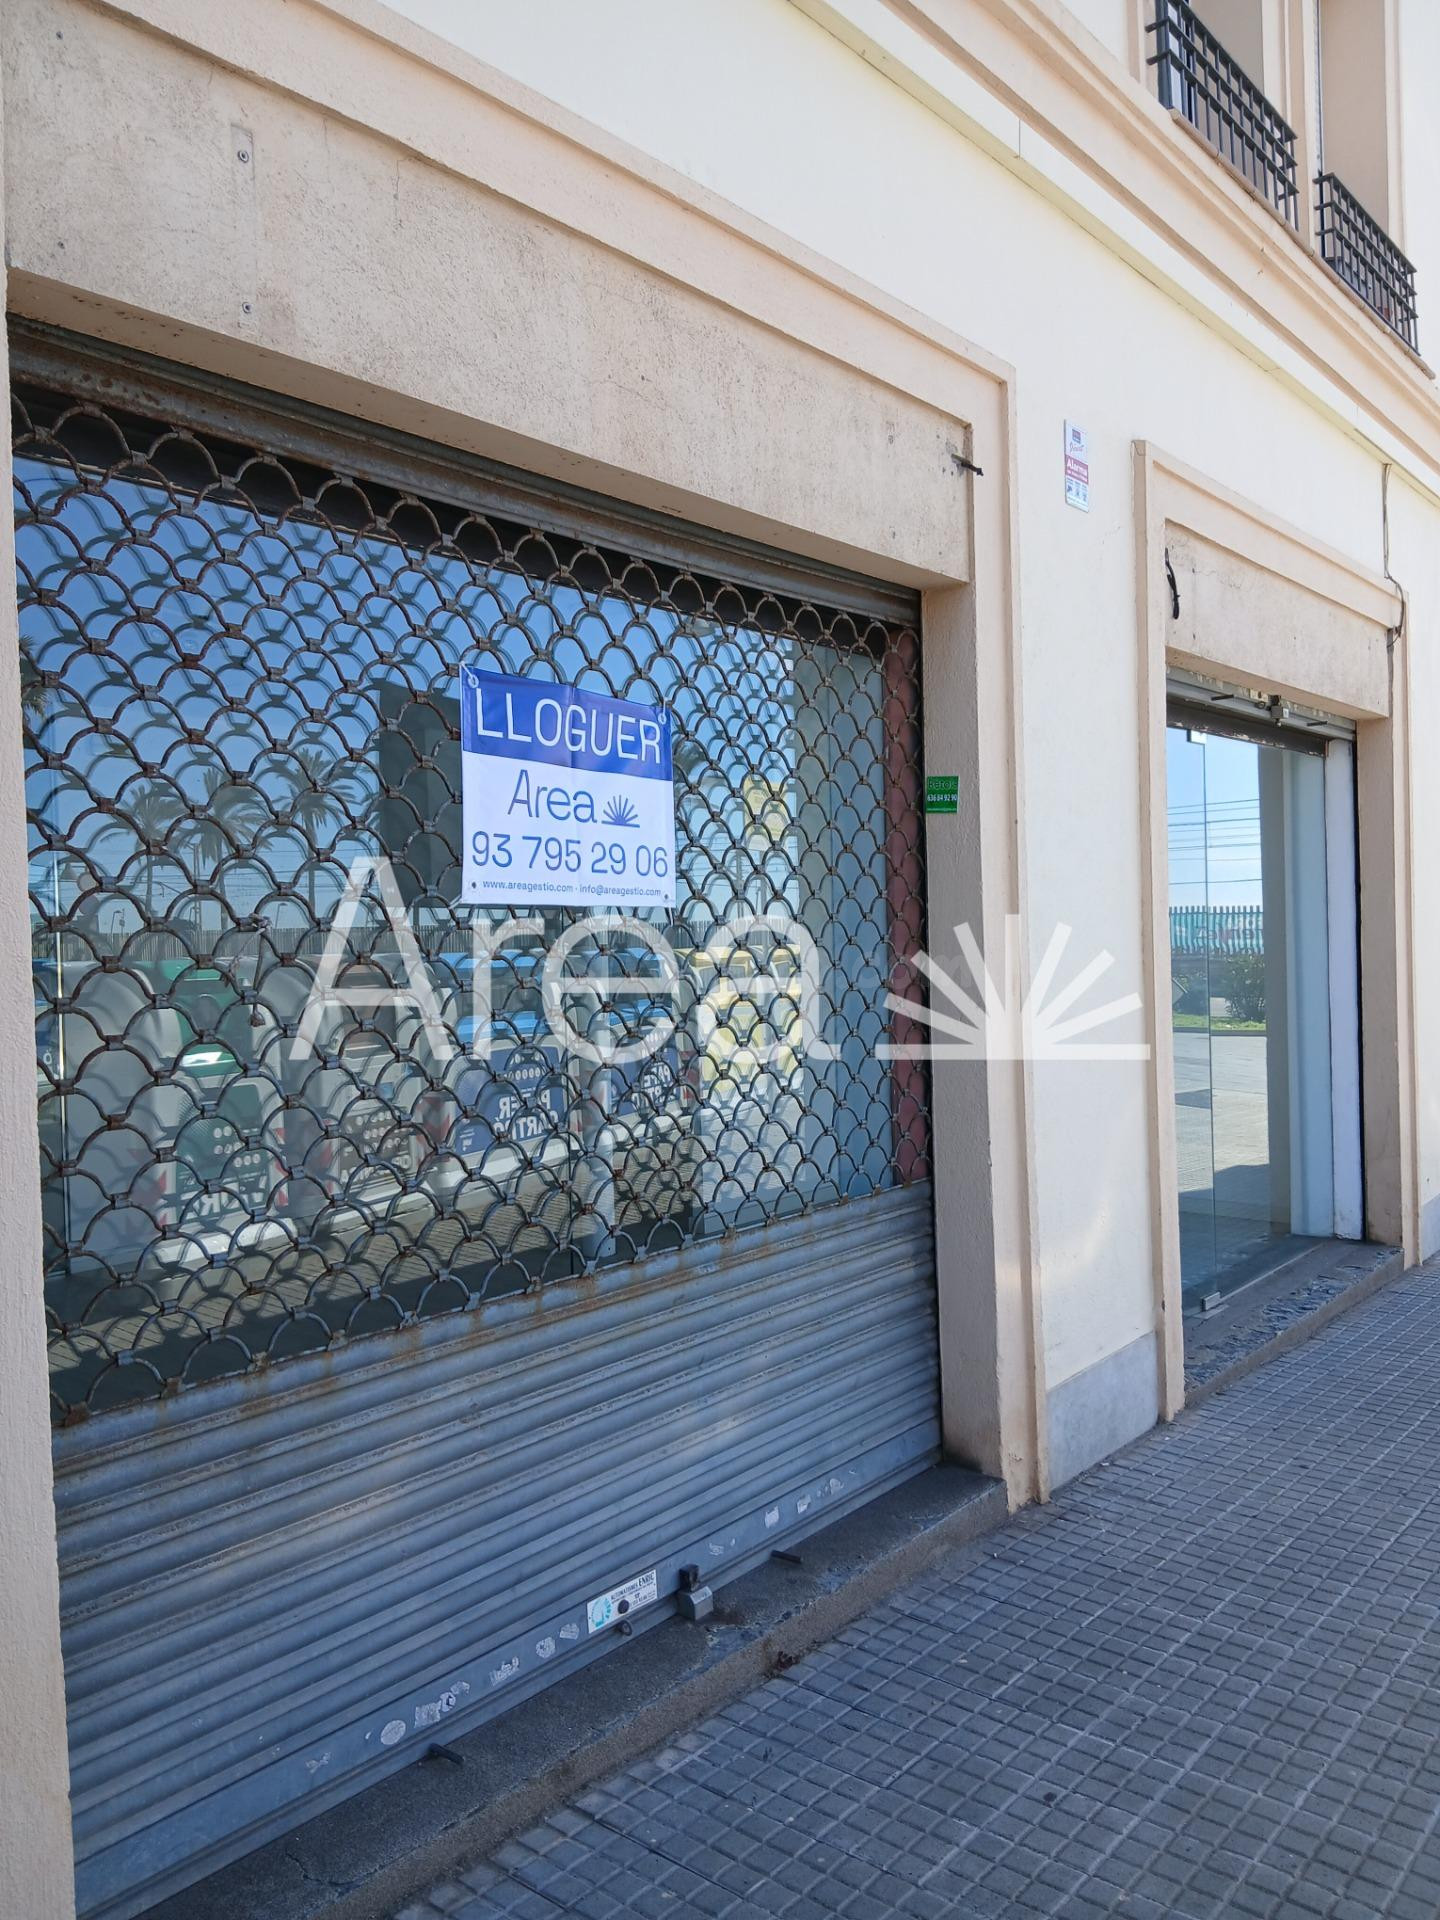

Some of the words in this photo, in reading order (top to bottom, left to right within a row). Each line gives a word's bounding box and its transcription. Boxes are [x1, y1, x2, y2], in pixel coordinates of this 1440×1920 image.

[475, 688, 661, 764] LLOGUER
[507, 769, 598, 824] Area
[472, 831, 512, 868] 93
[522, 836, 581, 872] 795
[591, 841, 626, 875] 29
[636, 844, 668, 878] 06
[482, 879, 574, 894] www.areagestio.com
[579, 884, 661, 897] info@areagestio.com
